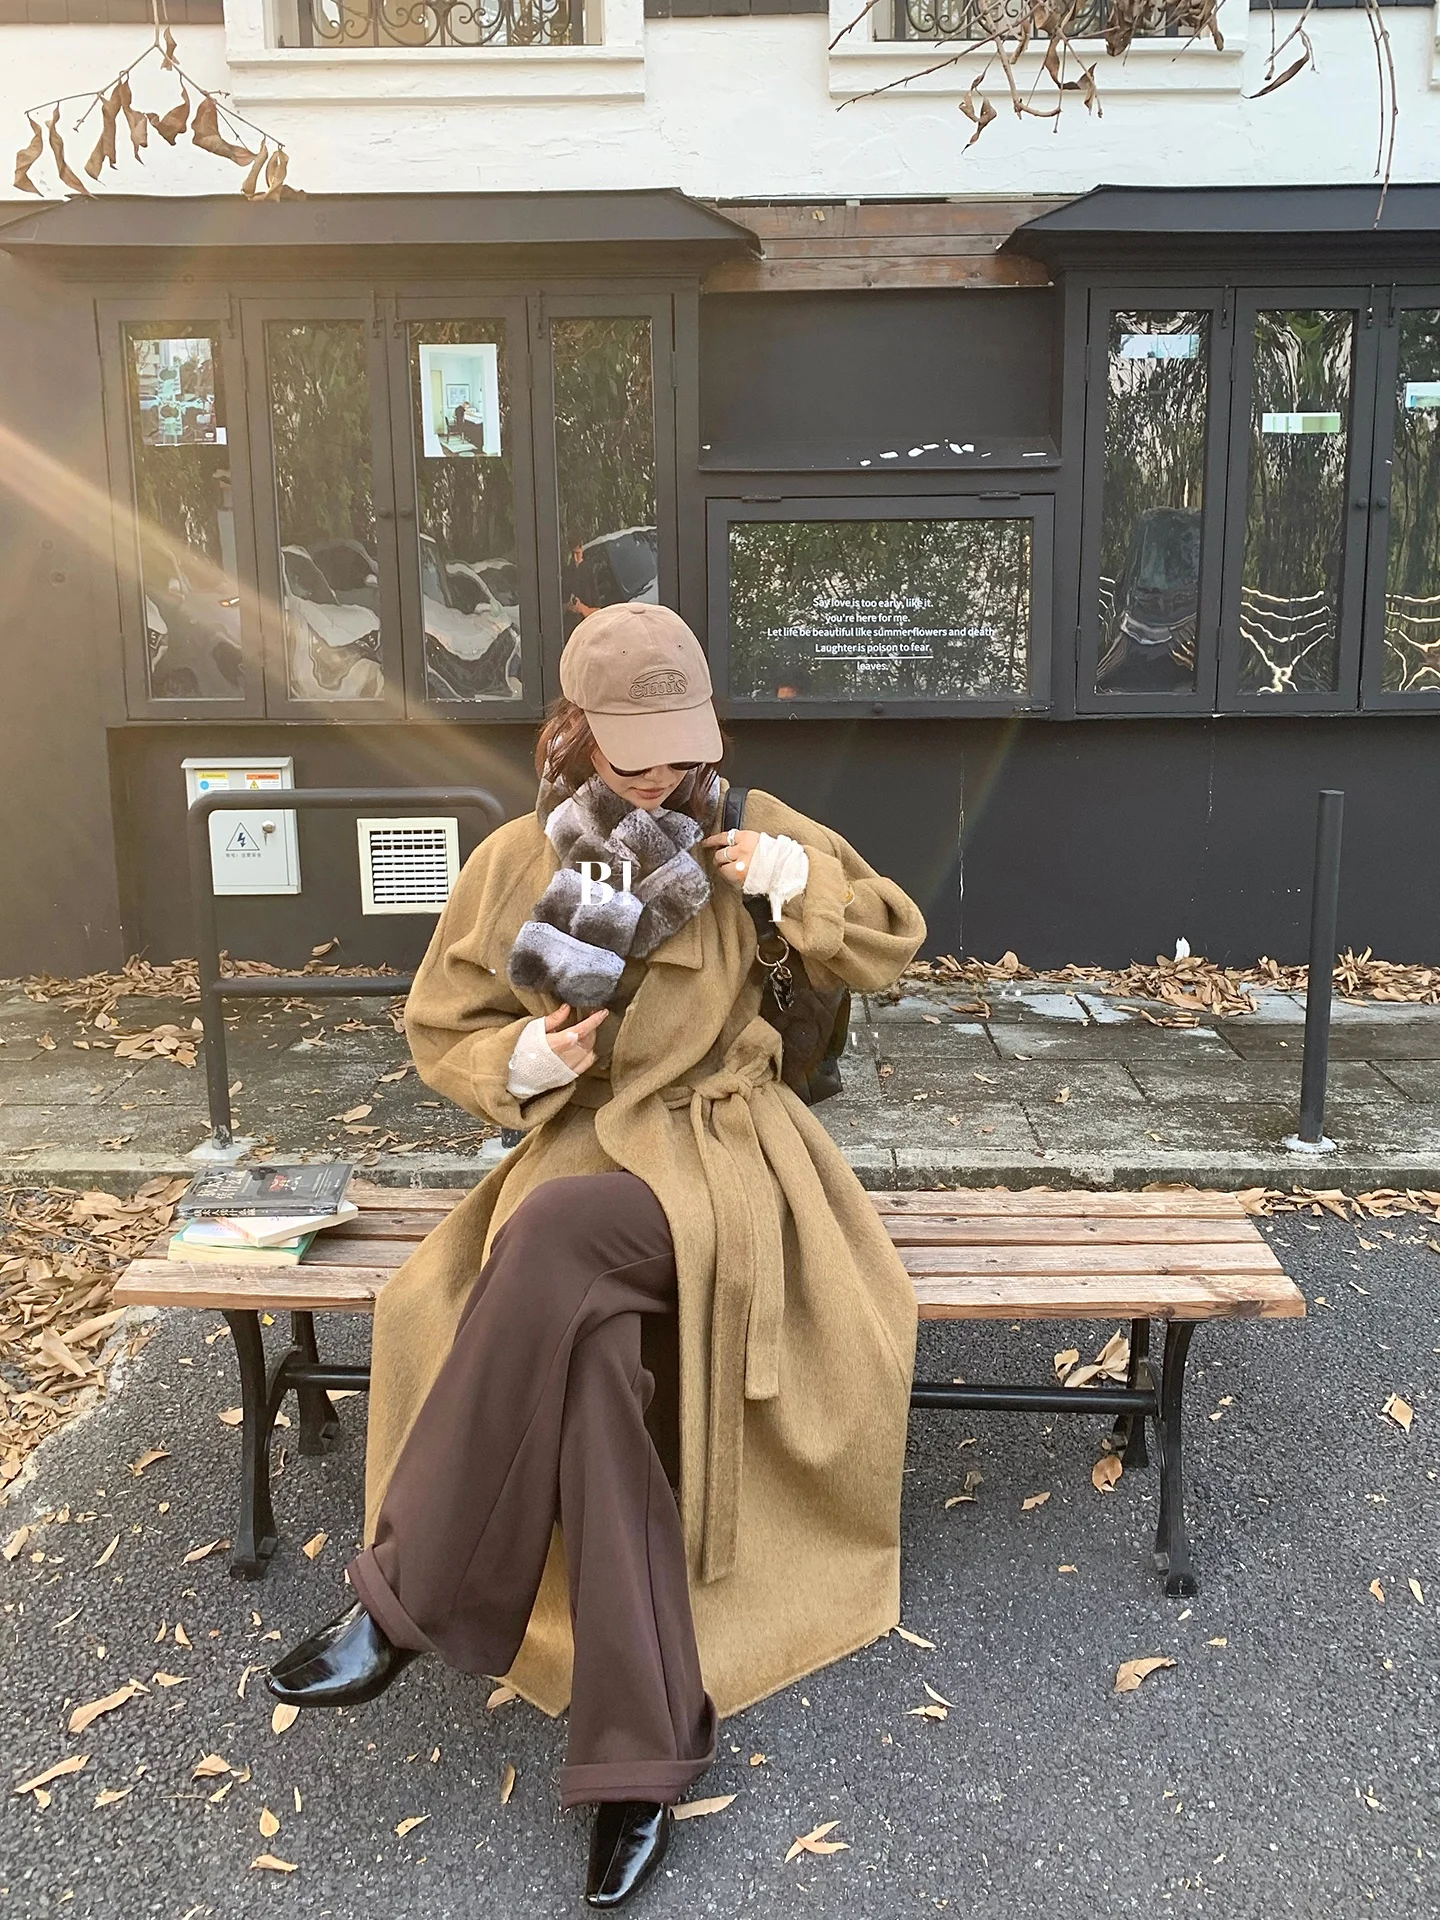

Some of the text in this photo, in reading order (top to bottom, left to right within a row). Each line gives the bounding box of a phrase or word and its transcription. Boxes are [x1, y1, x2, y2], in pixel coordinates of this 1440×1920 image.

[812, 598, 830, 608] Say
[832, 598, 851, 607] love
[852, 598, 860, 607] is
[861, 599, 877, 607] too
[906, 598, 923, 607] like
[924, 598, 934, 607] it.
[825, 613, 911, 624] you're here for me.
[767, 627, 995, 637] Let life be beautiful like summer flowers and death
[815, 642, 933, 654] Laughter is poison to fear.
[857, 661, 889, 671] leaves.
